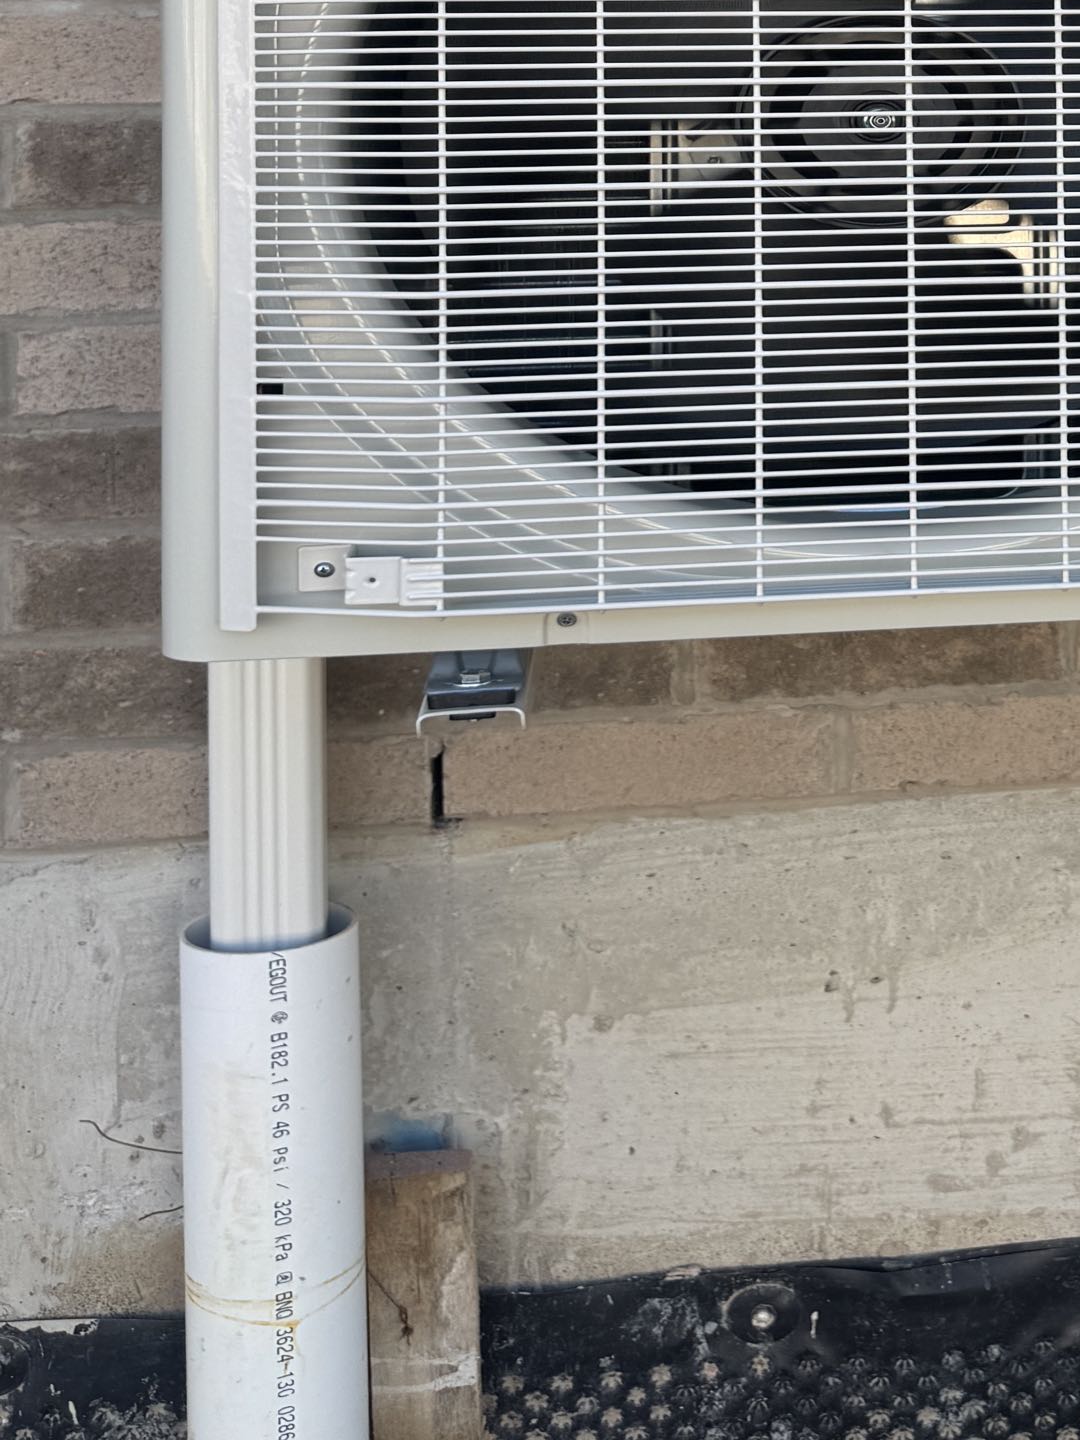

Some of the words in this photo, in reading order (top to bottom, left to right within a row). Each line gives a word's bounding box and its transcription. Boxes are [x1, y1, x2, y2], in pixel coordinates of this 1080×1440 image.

[270, 1031, 289, 1086] B182.1
[272, 1093, 290, 1113] PS
[273, 1120, 290, 1139] 46
[275, 1198, 293, 1227] 320
[275, 1234, 293, 1263] kPa
